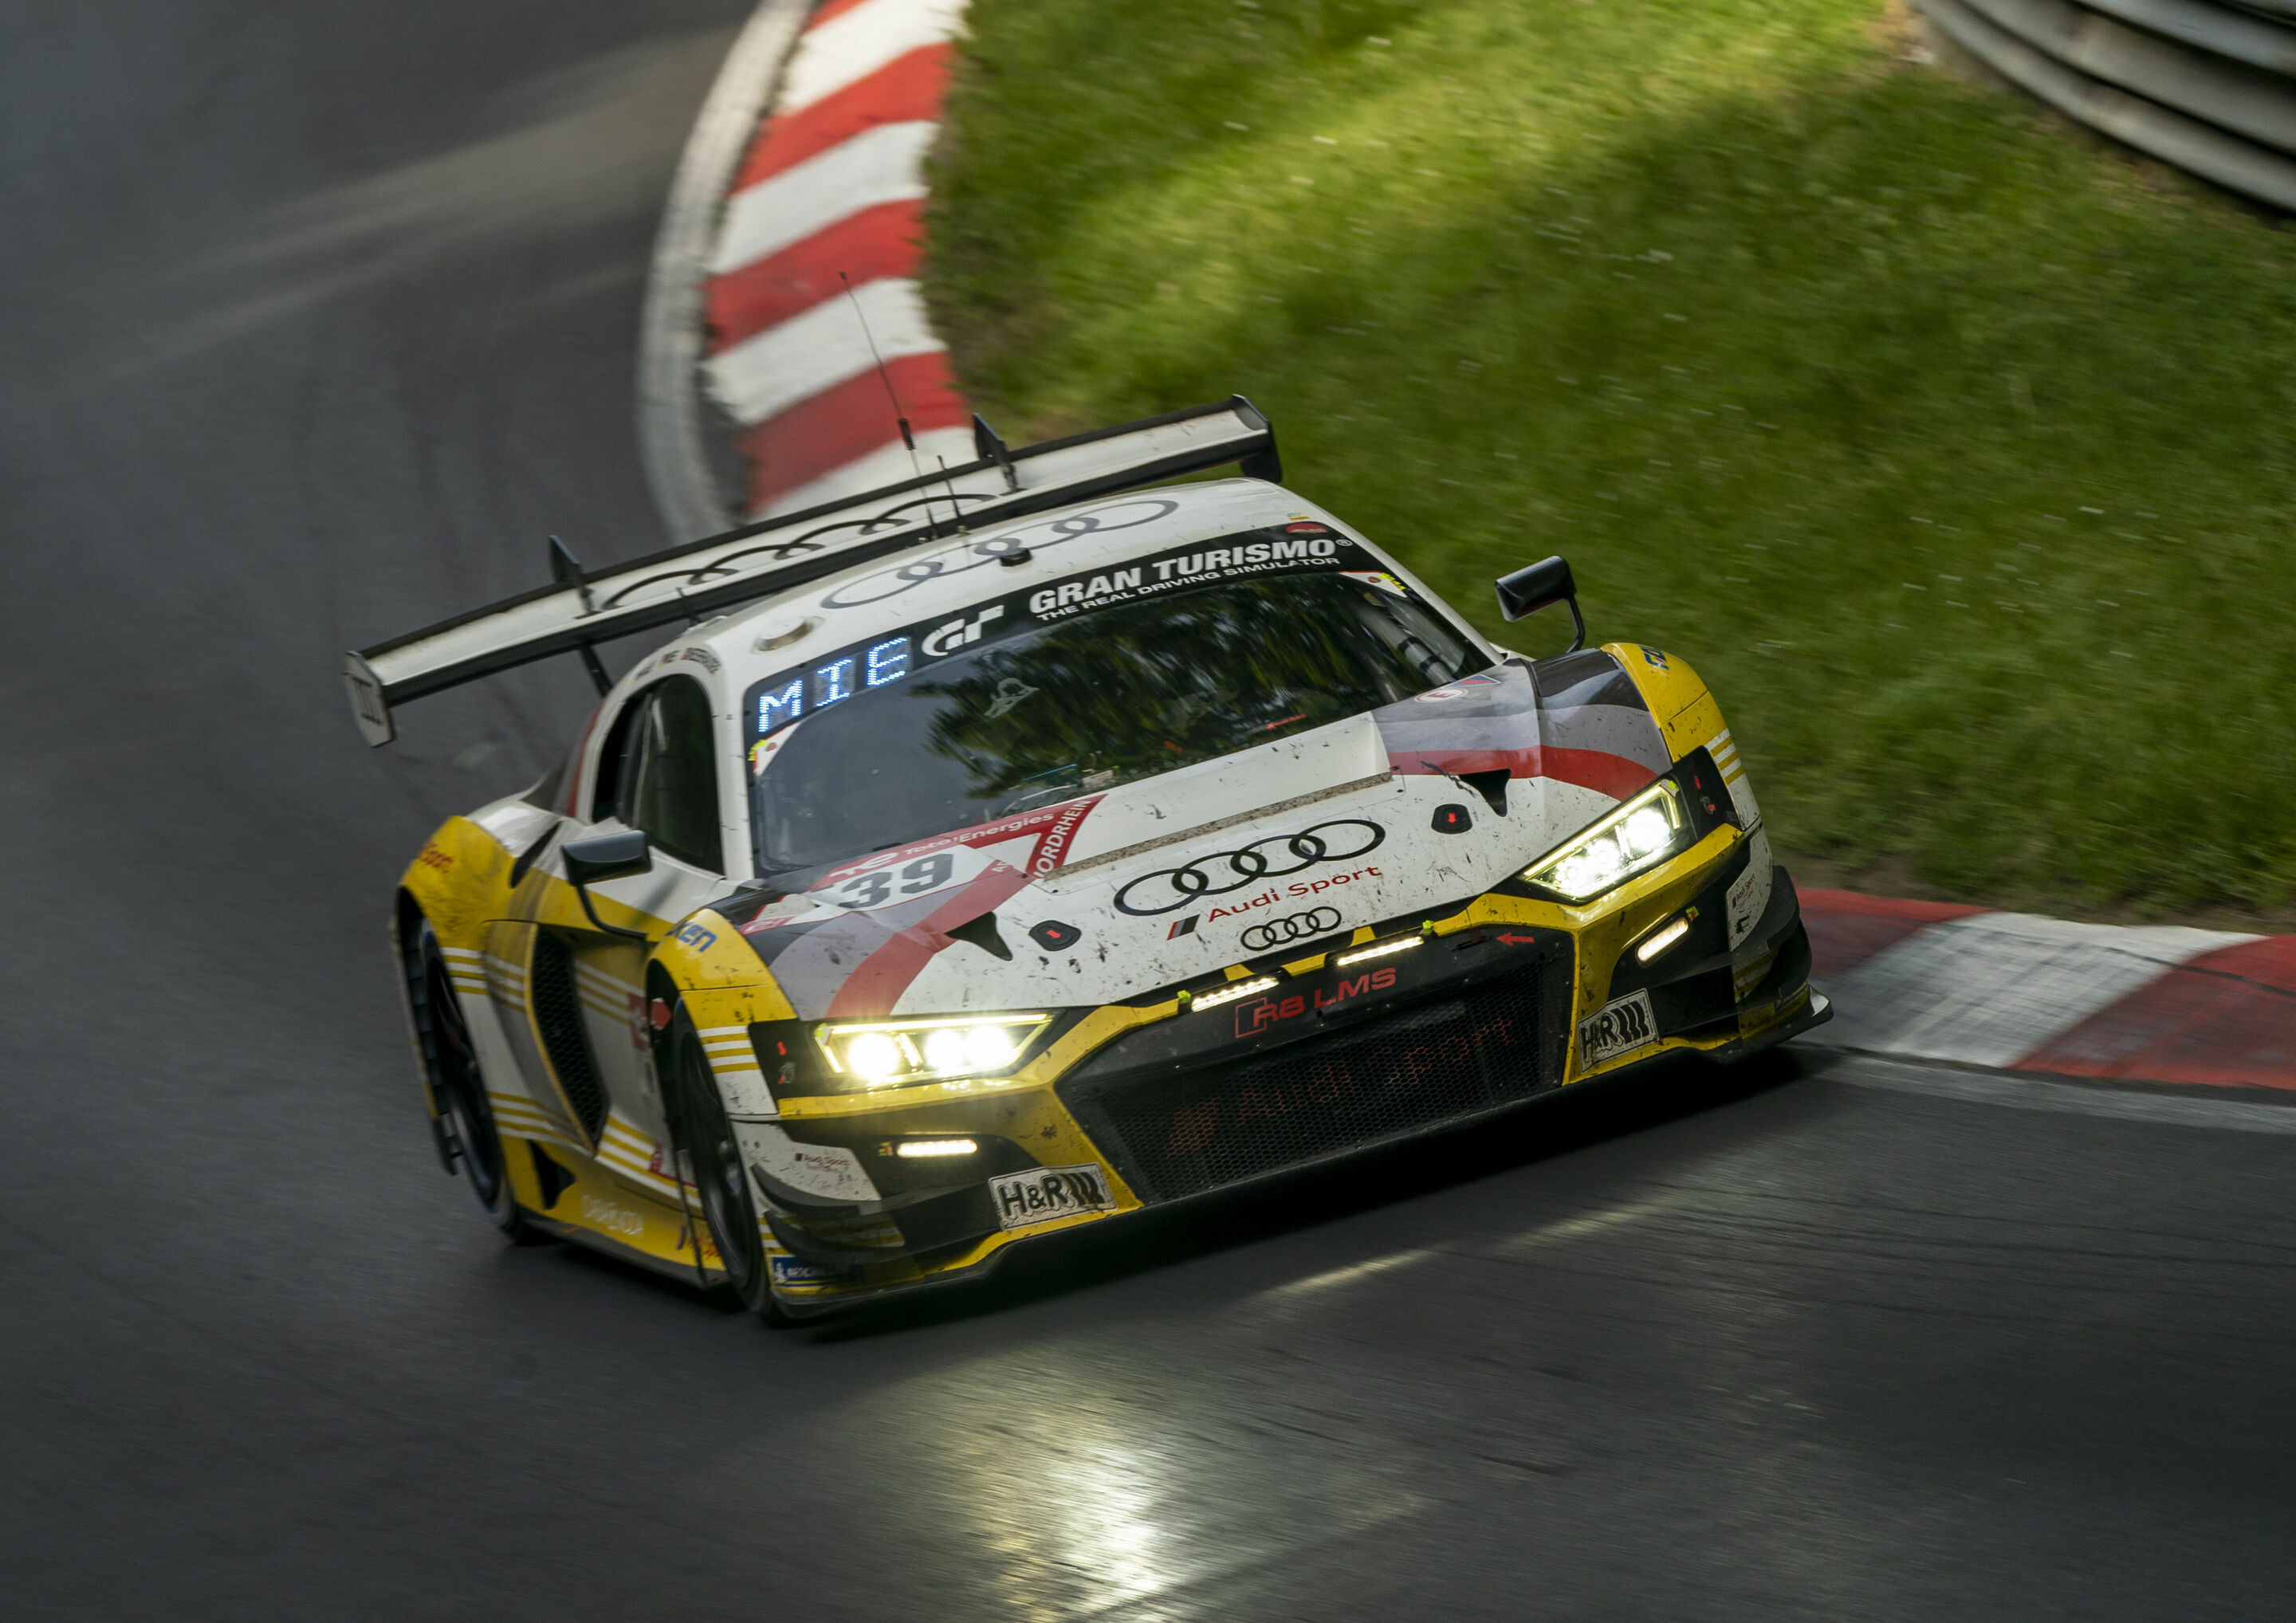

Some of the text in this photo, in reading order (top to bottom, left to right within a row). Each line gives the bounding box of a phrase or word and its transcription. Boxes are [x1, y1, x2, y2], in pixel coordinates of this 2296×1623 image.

[1028, 567, 1142, 615] GRAN
[1036, 557, 1341, 622] THE REAL DRIVING SIMULATOR
[758, 637, 907, 733] MIE
[838, 854, 953, 908] 39
[1209, 867, 1383, 922] Audi Sport
[1252, 967, 1397, 1028] R8 LMS
[998, 1175, 1069, 1216] H&R
